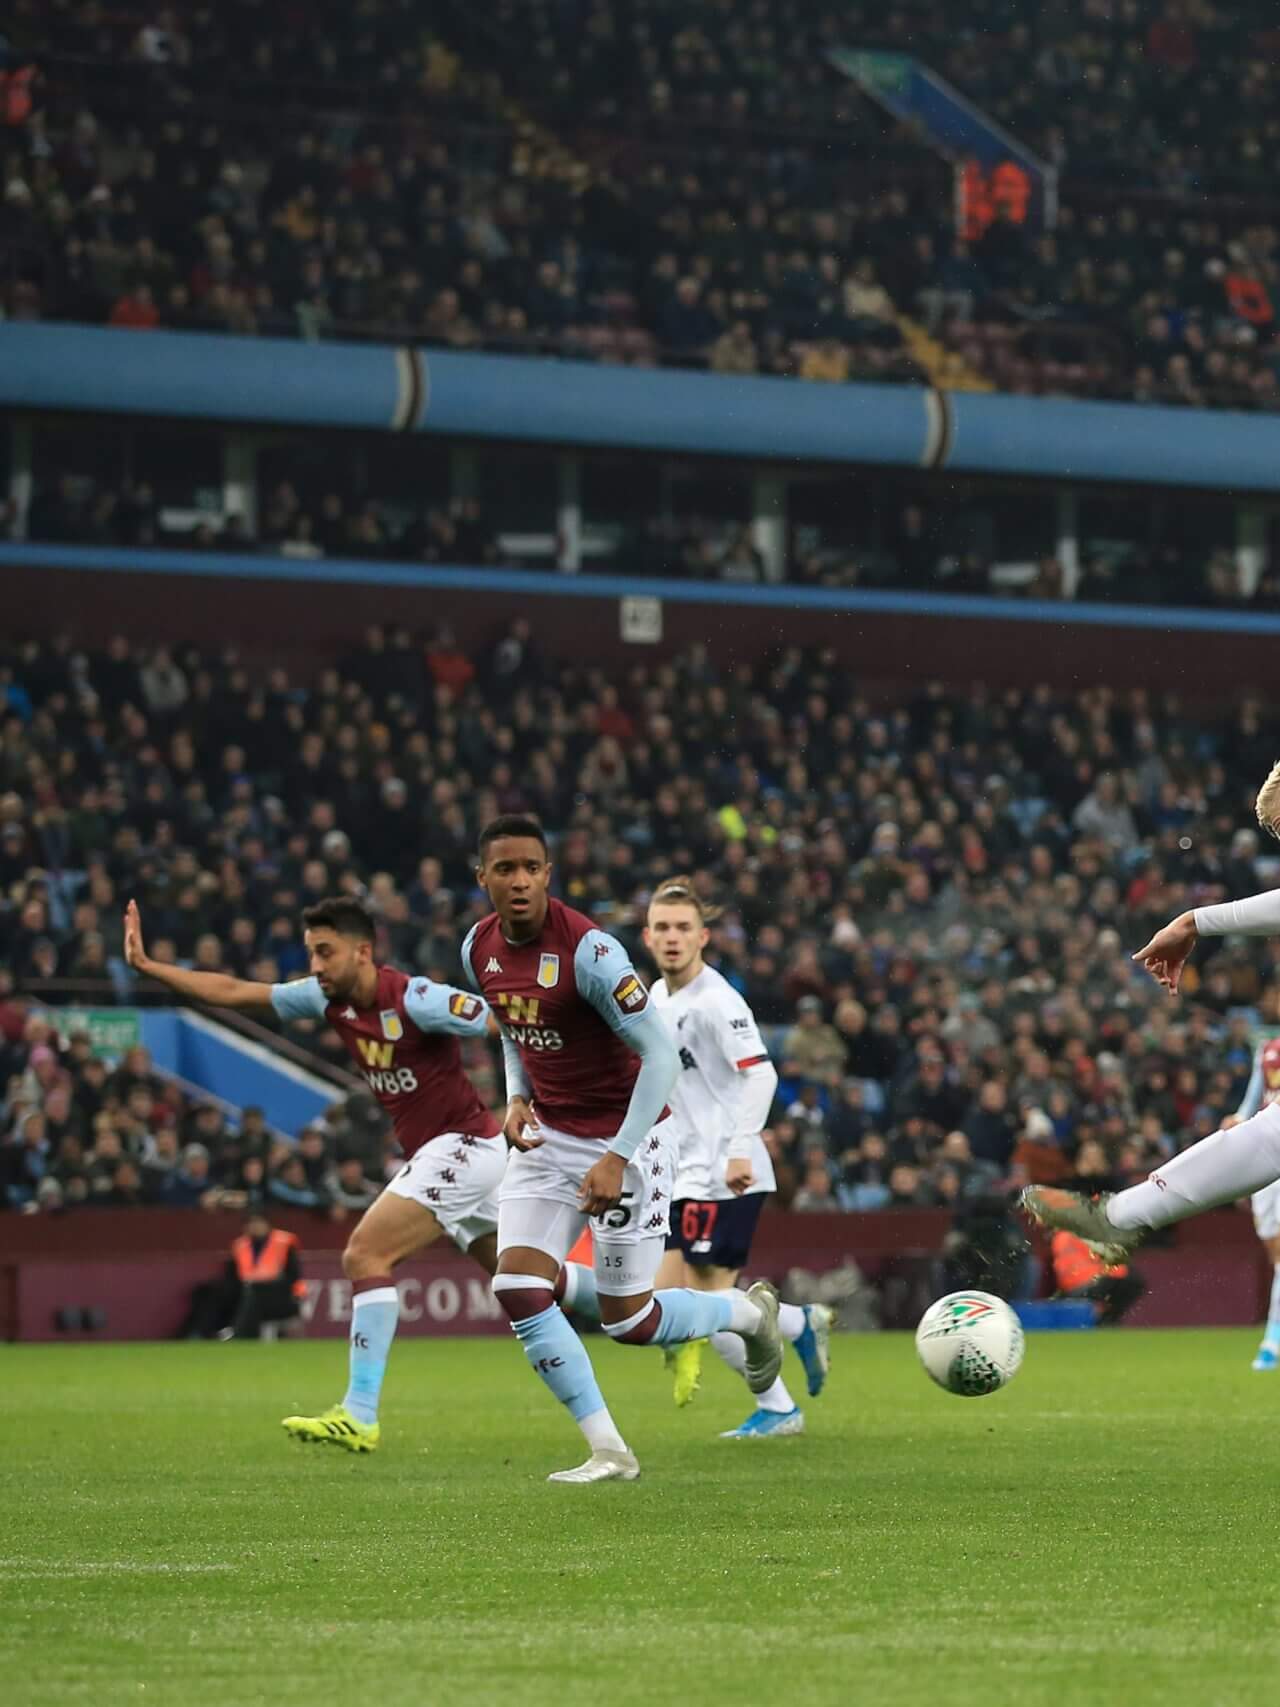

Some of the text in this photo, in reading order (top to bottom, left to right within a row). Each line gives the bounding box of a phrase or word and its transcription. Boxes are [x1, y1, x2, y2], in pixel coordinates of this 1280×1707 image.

[361, 1066, 418, 1095] W88
[598, 1191, 632, 1228] 5
[682, 1202, 718, 1240] 67
[604, 1256, 623, 1268] 15
[534, 1356, 566, 1374] fc
